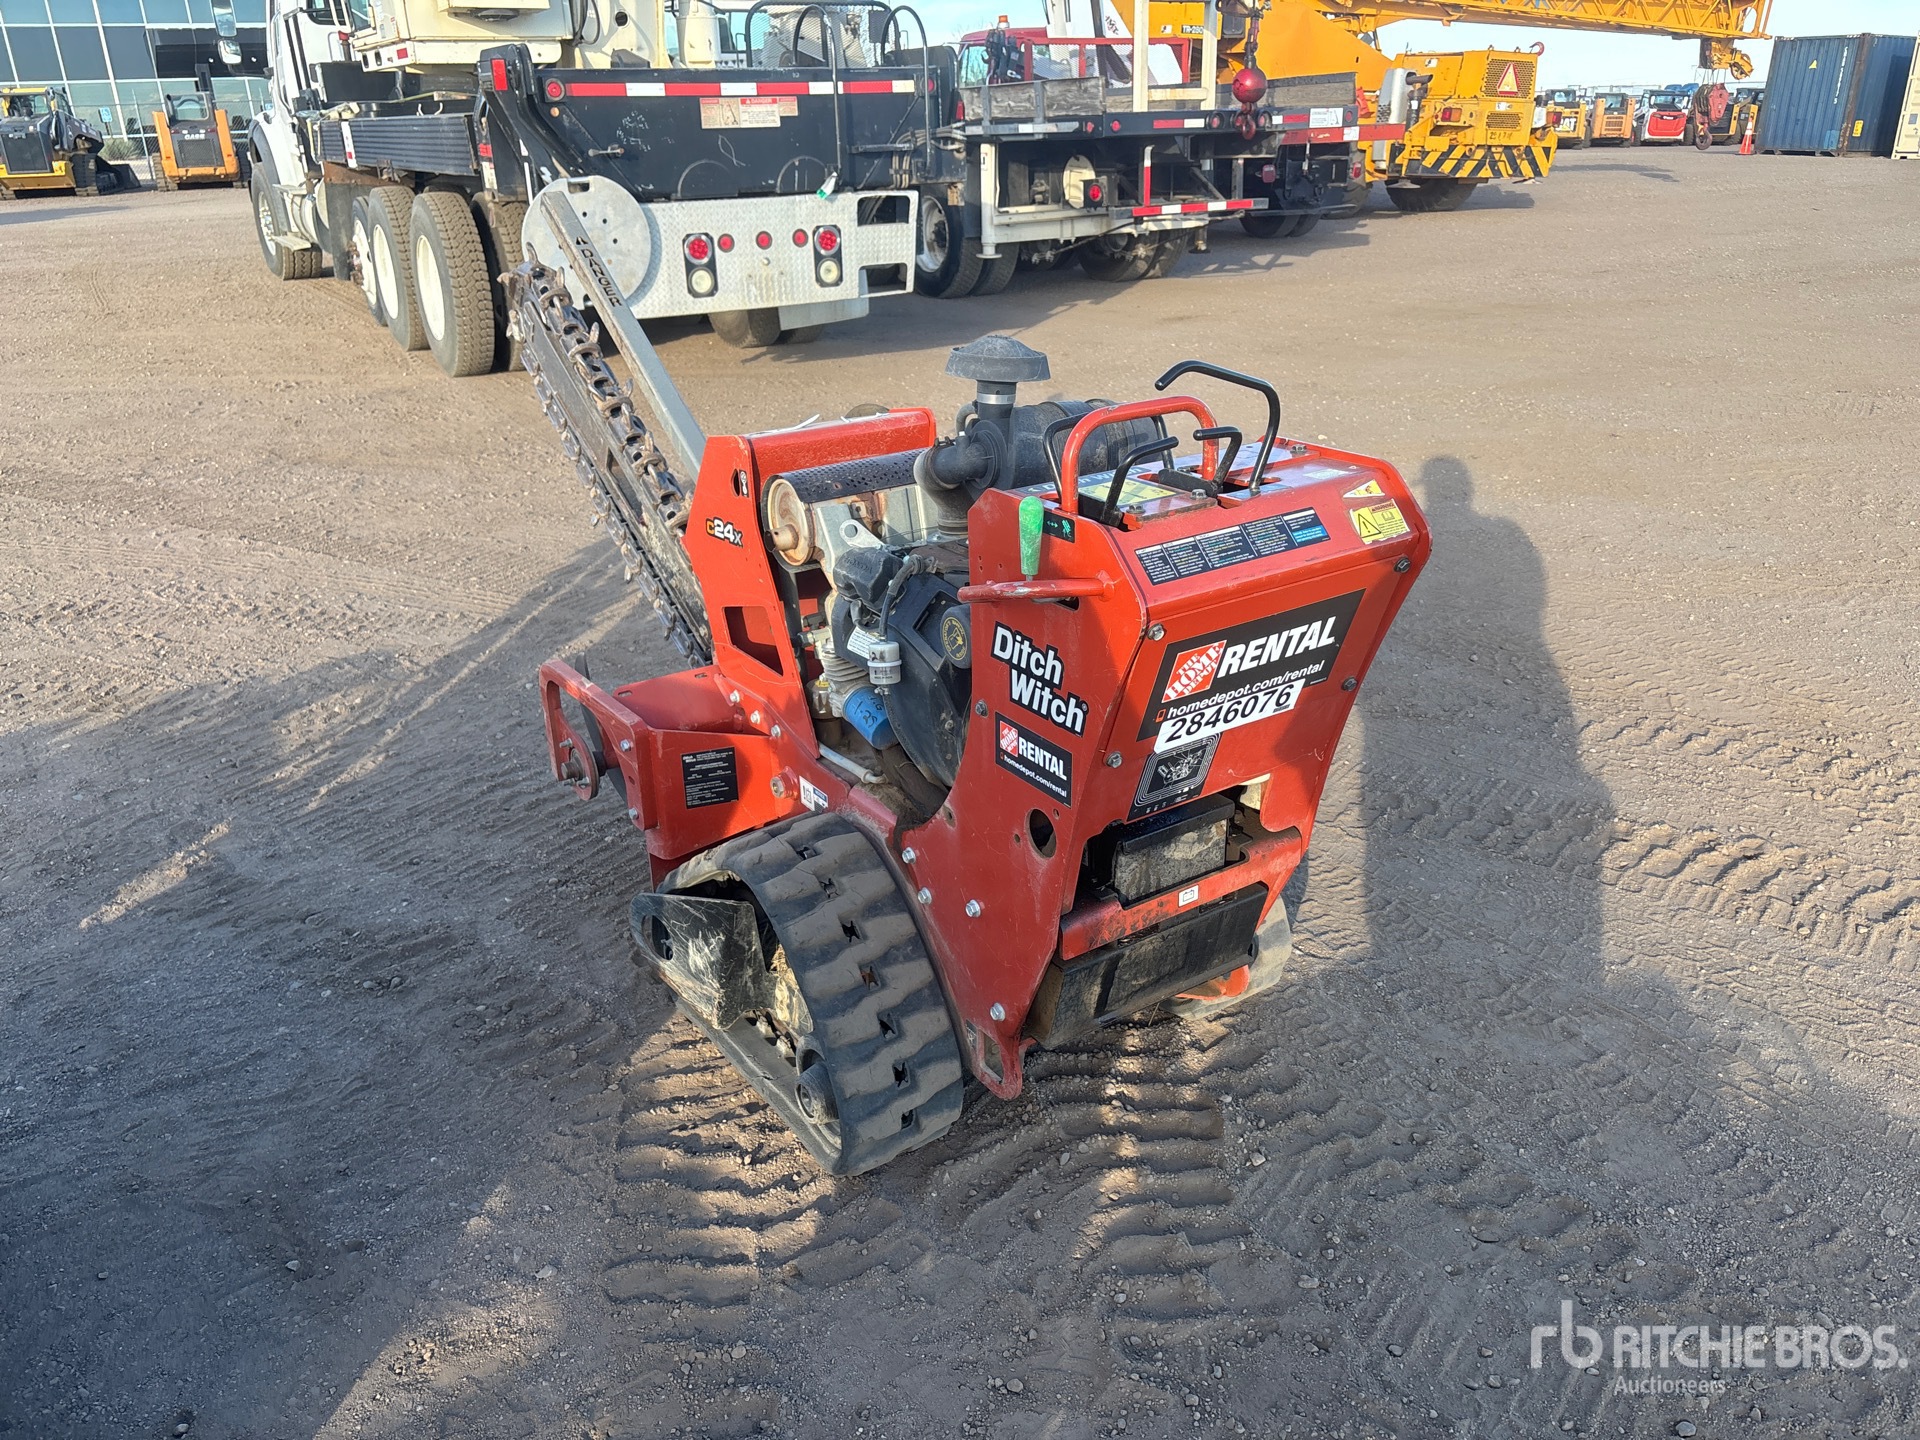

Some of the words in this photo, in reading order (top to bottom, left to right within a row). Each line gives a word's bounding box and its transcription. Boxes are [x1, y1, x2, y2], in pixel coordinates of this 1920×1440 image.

[581, 248, 622, 307] DANGER
[993, 626, 1062, 685] Ditch
[1165, 643, 1224, 700] HOME
[1176, 653, 1200, 675] THE
[1217, 616, 1336, 678] RENTAL
[1166, 660, 1325, 720] homedepot.com/rental
[1183, 659, 1219, 695] DEPOT
[1165, 684, 1294, 743] 2846076
[1003, 755, 1067, 797] homedepot.com/rental
[1019, 737, 1067, 780] RENTAL
